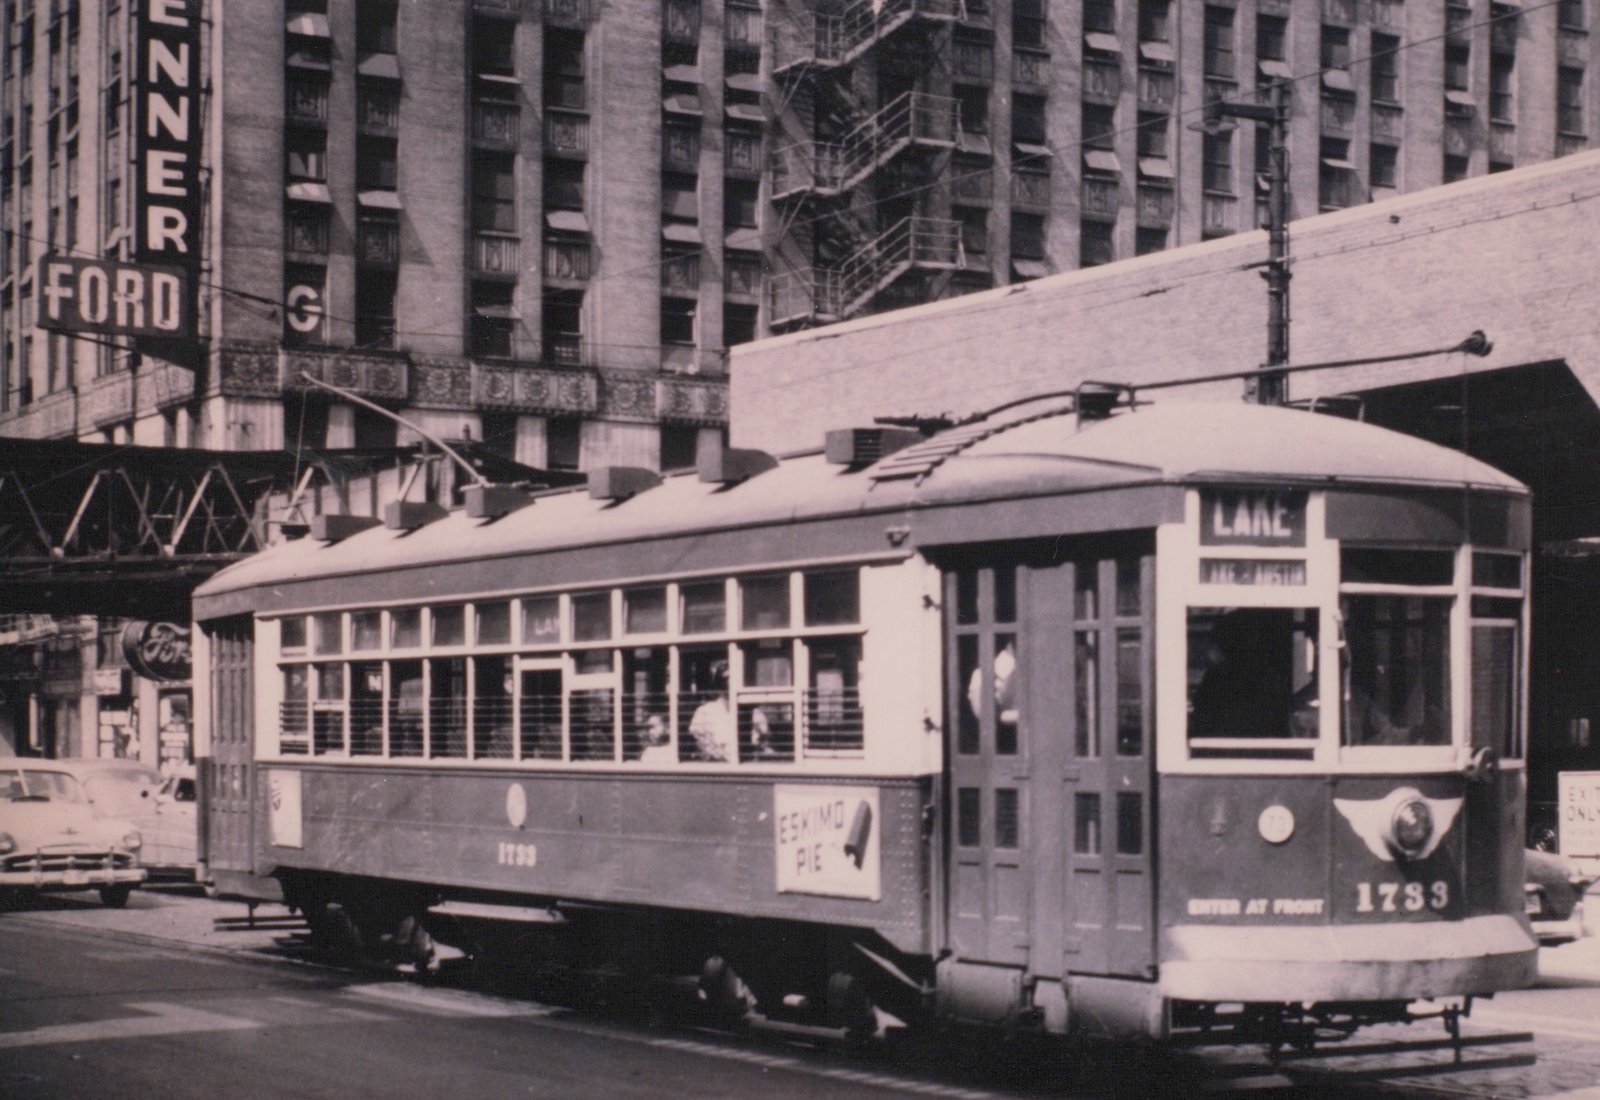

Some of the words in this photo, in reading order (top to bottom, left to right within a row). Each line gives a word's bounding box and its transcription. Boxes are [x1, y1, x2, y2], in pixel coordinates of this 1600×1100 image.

[44, 262, 180, 330] FORD
[780, 800, 843, 844] ESKIMO
[796, 843, 822, 876] PIE
[1188, 899, 1241, 915] ENTER
[1245, 899, 1268, 915] AT
[1273, 898, 1325, 914] FRONT
[1356, 881, 1449, 912] 1733
